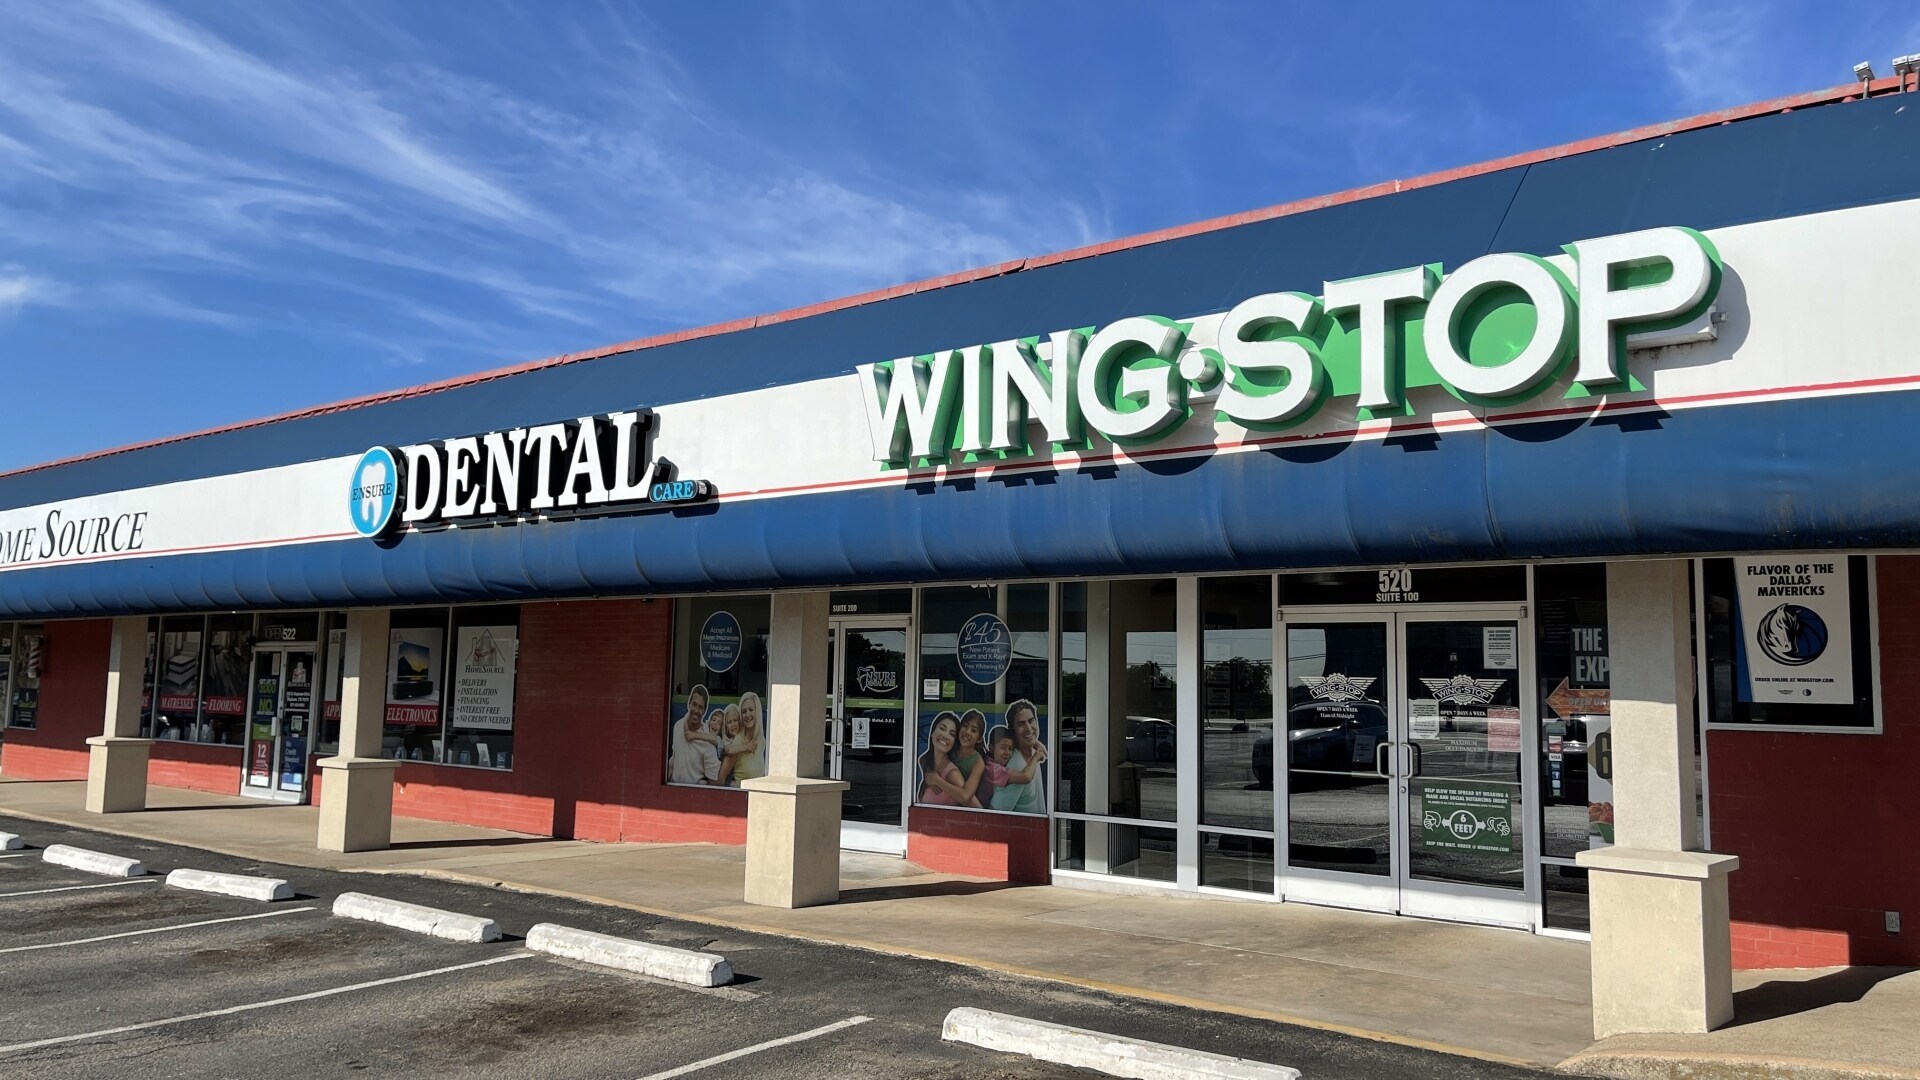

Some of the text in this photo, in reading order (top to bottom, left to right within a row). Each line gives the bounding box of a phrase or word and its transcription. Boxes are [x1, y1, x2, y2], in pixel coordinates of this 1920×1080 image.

[402, 412, 655, 522] DENTAL
[352, 482, 393, 500] ENSURE
[652, 480, 695, 501] CARE
[0, 528, 36, 564] ME
[1747, 563, 1834, 575] FLAVOR OF THE
[1379, 568, 1412, 593] 520
[1770, 575, 1811, 585] DALLAS
[1376, 592, 1419, 602] SUITE 100
[1758, 586, 1825, 596] MAVERICKS
[832, 604, 857, 612] SUITE 200
[283, 627, 296, 640] 522
[710, 627, 725, 635] Accept
[965, 621, 1003, 644] $45
[1571, 628, 1602, 652] THE
[208, 699, 241, 712] FLOORING
[259, 698, 273, 712] NO
[460, 697, 490, 705] FINANCING
[1568, 697, 1592, 706] OPEN
[386, 707, 438, 723] ELECTRONICS
[460, 706, 485, 714] INTEREST
[488, 716, 511, 724] NEEDED
[258, 744, 267, 758] 12
[1460, 814, 1467, 823] 6
[1454, 823, 1473, 834] FEET
